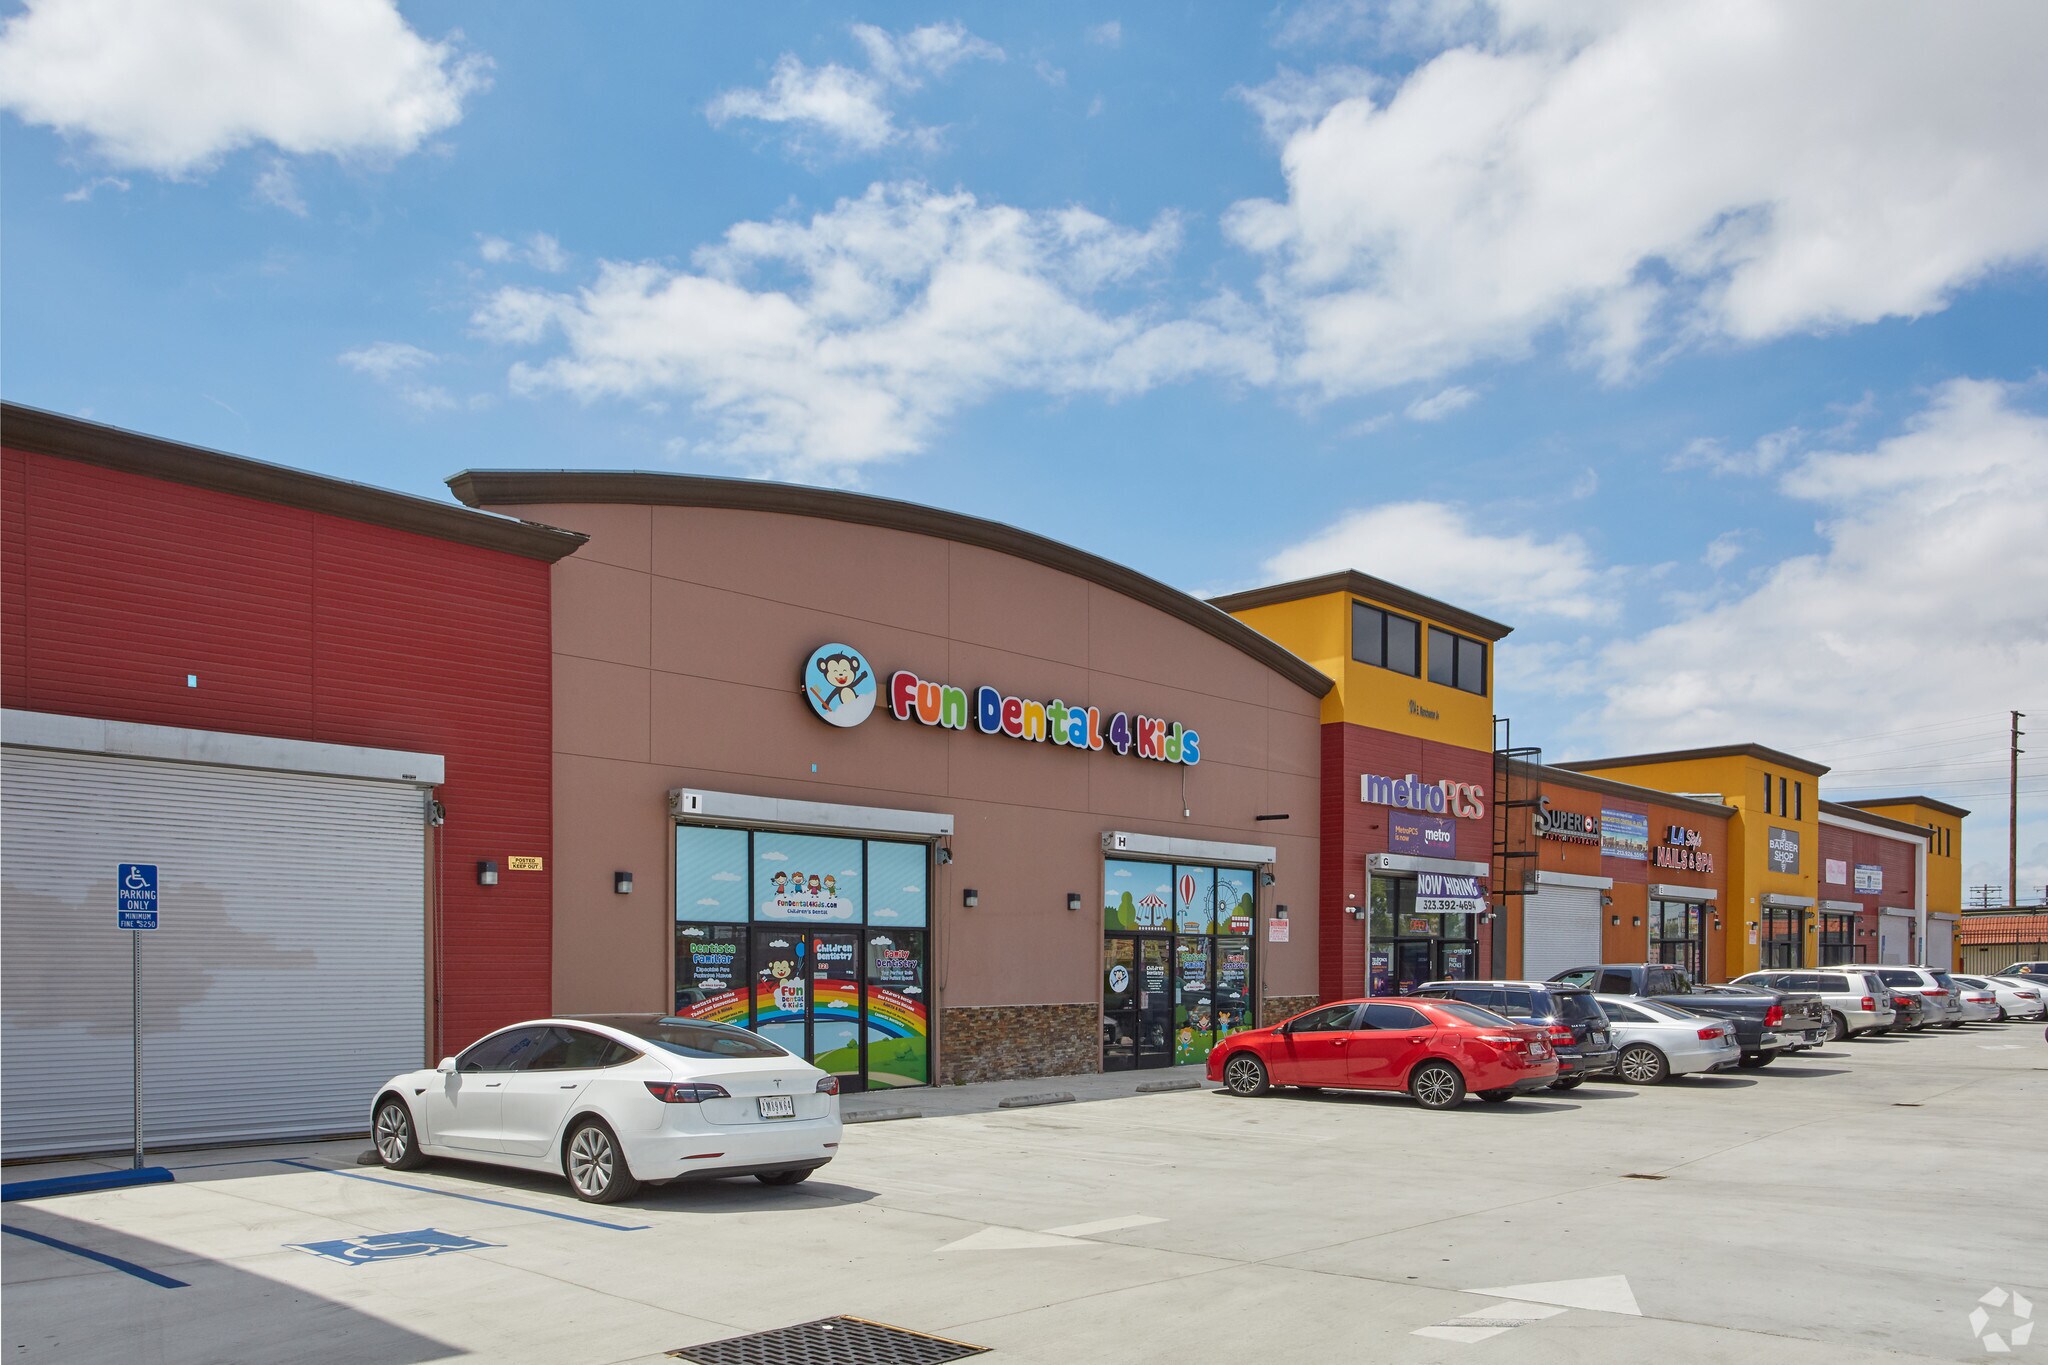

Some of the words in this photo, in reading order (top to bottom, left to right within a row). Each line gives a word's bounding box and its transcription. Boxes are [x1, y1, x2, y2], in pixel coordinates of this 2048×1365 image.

[887, 670, 967, 731] Fun
[974, 685, 1103, 752] Dental
[1107, 711, 1131, 756] 4
[1133, 714, 1201, 767] Kids
[1535, 796, 1599, 835] SUPERIOR
[1395, 825, 1419, 836] MetroPCS
[1425, 829, 1450, 842] metro
[1669, 825, 1685, 846] LA
[1118, 837, 1126, 847] H
[1769, 839, 1799, 853] BARBER
[1656, 846, 1688, 870] NAILS
[1689, 853, 1695, 869] &
[1695, 851, 1714, 873] SPA
[1774, 850, 1794, 861] SHOP
[1383, 857, 1389, 866] G
[1417, 874, 1442, 895] NOW
[1443, 876, 1479, 897] HIRING
[120, 889, 156, 900] PARKING
[127, 900, 150, 910] ONLY
[1423, 900, 1477, 910] 323.392-4694
[690, 943, 737, 954] Dentista
[816, 944, 853, 953] Children
[884, 949, 910, 959] Family
[693, 953, 734, 964] Familiar
[817, 952, 853, 961] Dentistry
[876, 959, 917, 969] Dentistry
[781, 985, 804, 996] Fun
